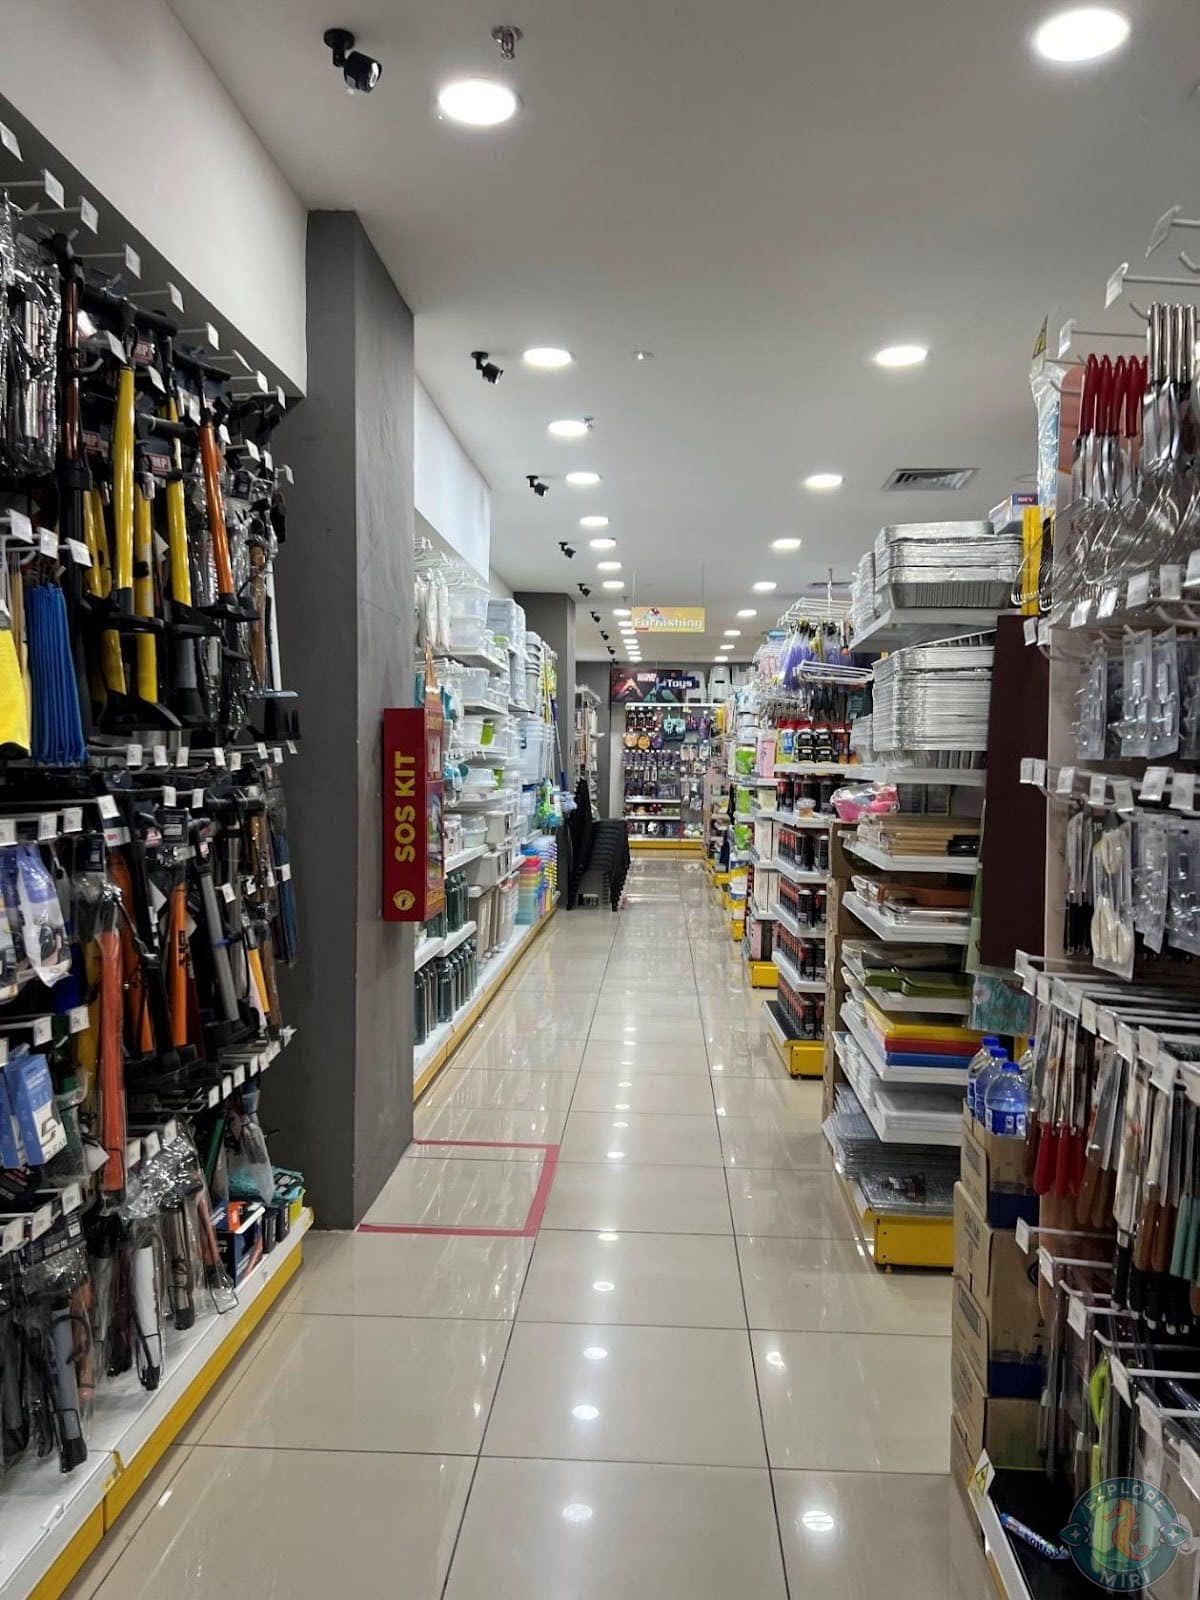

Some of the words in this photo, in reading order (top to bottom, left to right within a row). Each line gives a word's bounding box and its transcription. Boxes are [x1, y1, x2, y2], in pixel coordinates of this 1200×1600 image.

[634, 617, 702, 629] Furnishing
[667, 679, 692, 689] Toys
[394, 751, 416, 798] KIT
[394, 805, 416, 863] SOS
